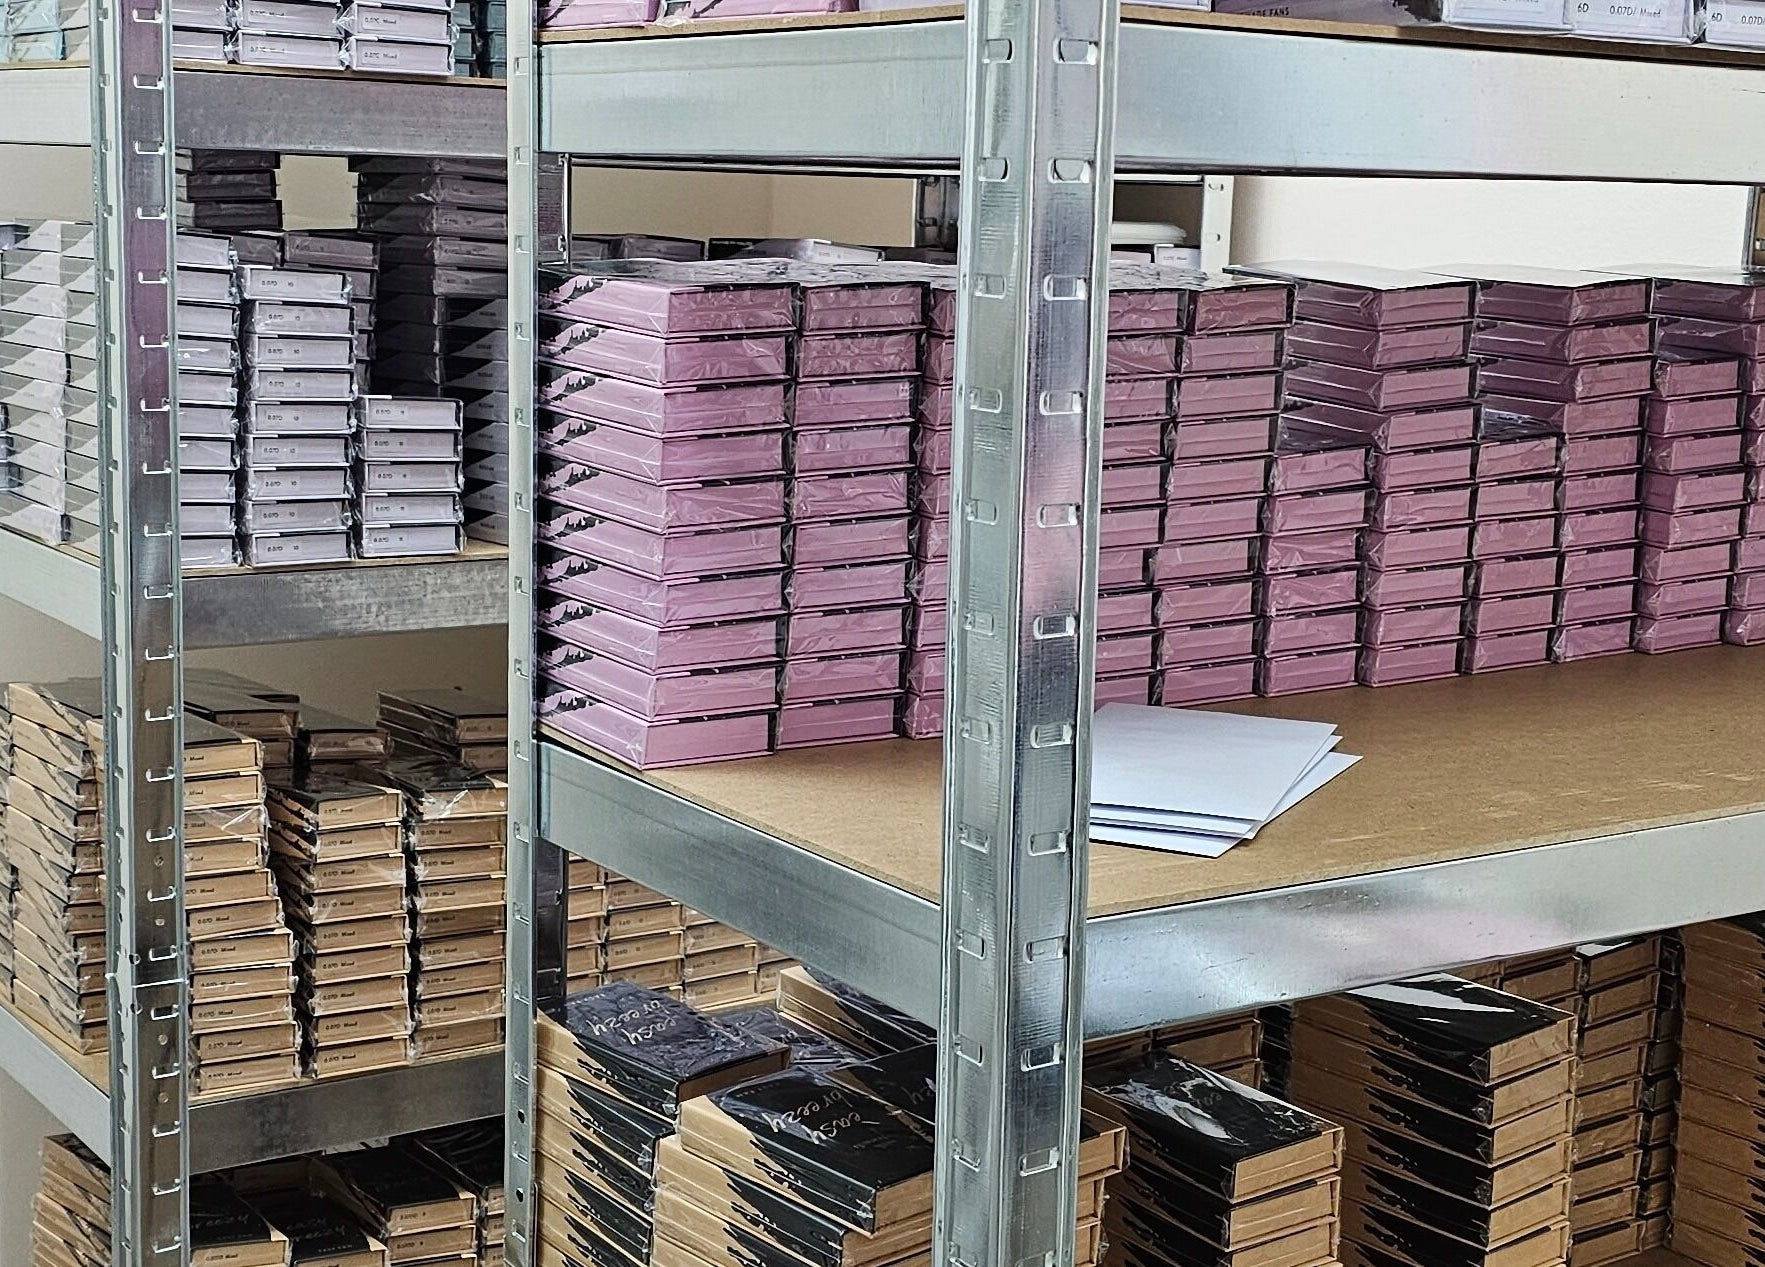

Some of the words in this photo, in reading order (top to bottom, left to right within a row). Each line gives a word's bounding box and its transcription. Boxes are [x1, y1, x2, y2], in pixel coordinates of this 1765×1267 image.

[1577, 2, 1589, 13] 6D
[1711, 12, 1723, 22] 6D
[585, 1000, 670, 1036] breezy
[621, 1016, 676, 1045] easy
[761, 1089, 852, 1133] breezy
[801, 1112, 862, 1145] easy
